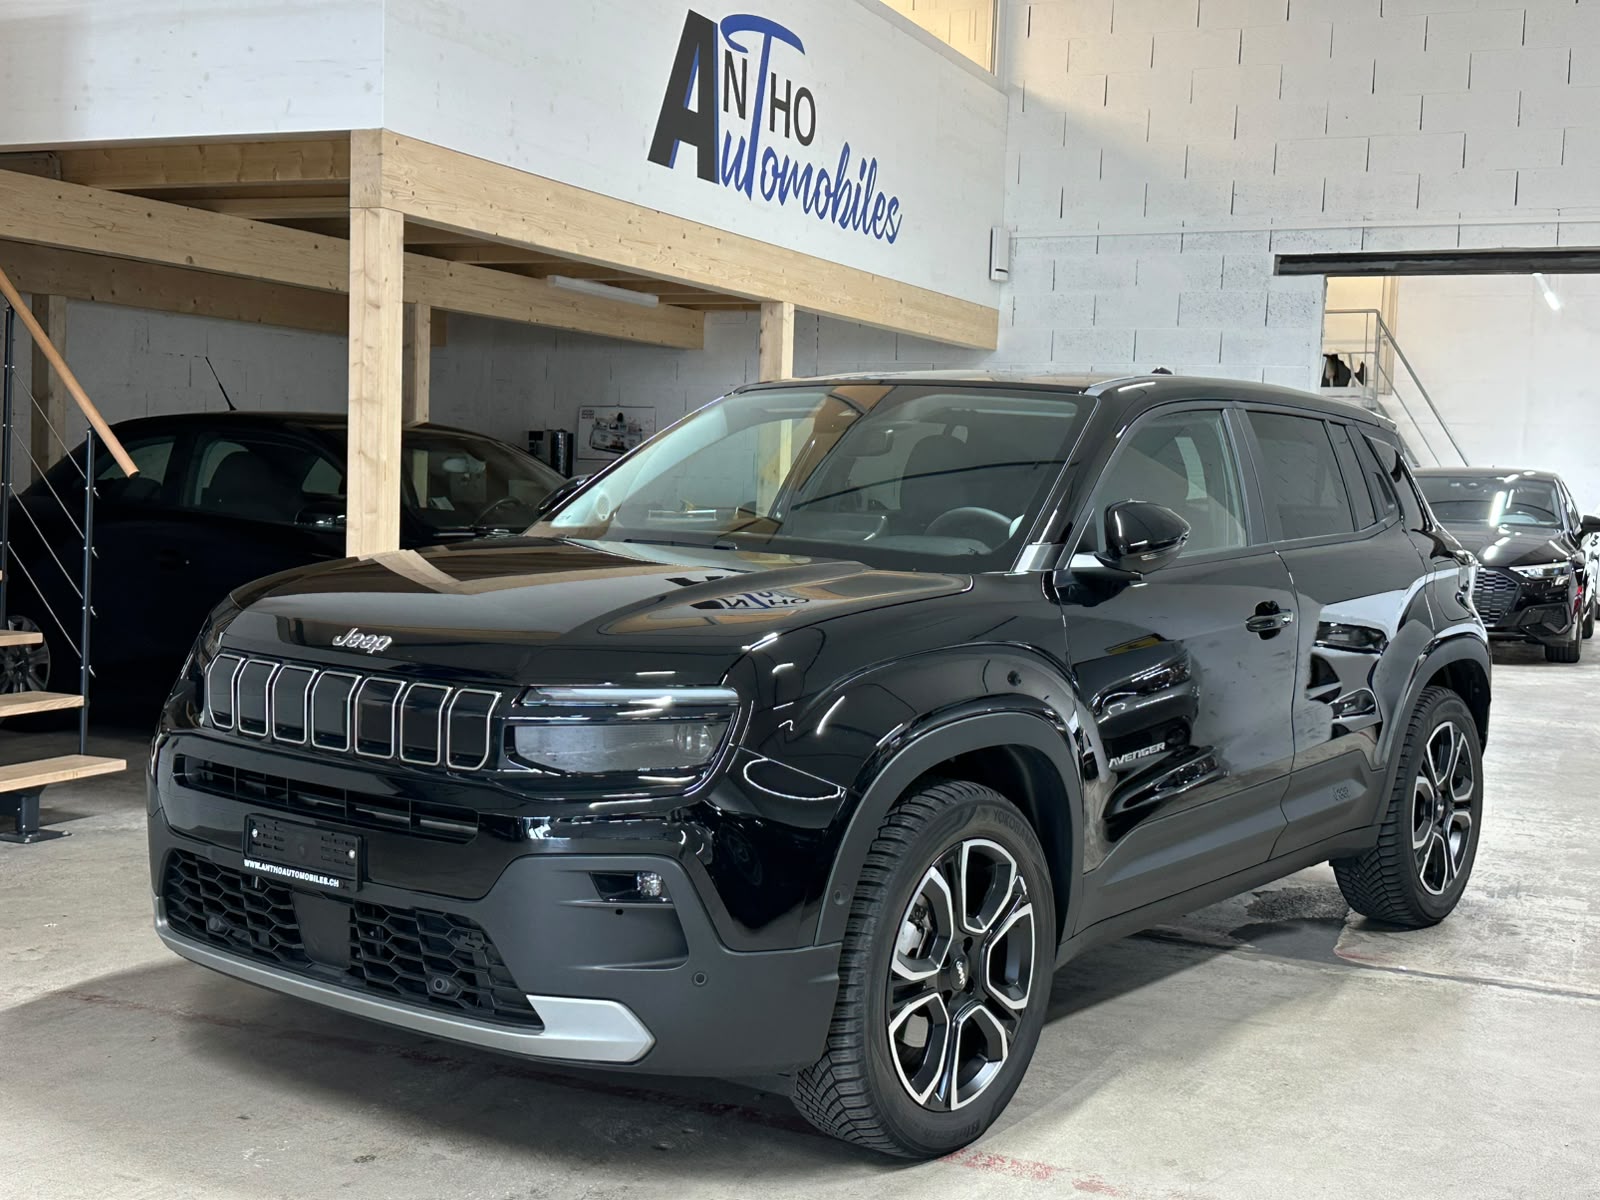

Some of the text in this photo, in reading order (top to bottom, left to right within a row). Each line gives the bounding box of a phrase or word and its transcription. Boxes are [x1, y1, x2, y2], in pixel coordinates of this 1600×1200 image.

[332, 627, 393, 654] Jeep
[1108, 741, 1166, 769] AVENGER
[243, 858, 340, 888] WWW.ANTHOAUTOMOBILES.CH
